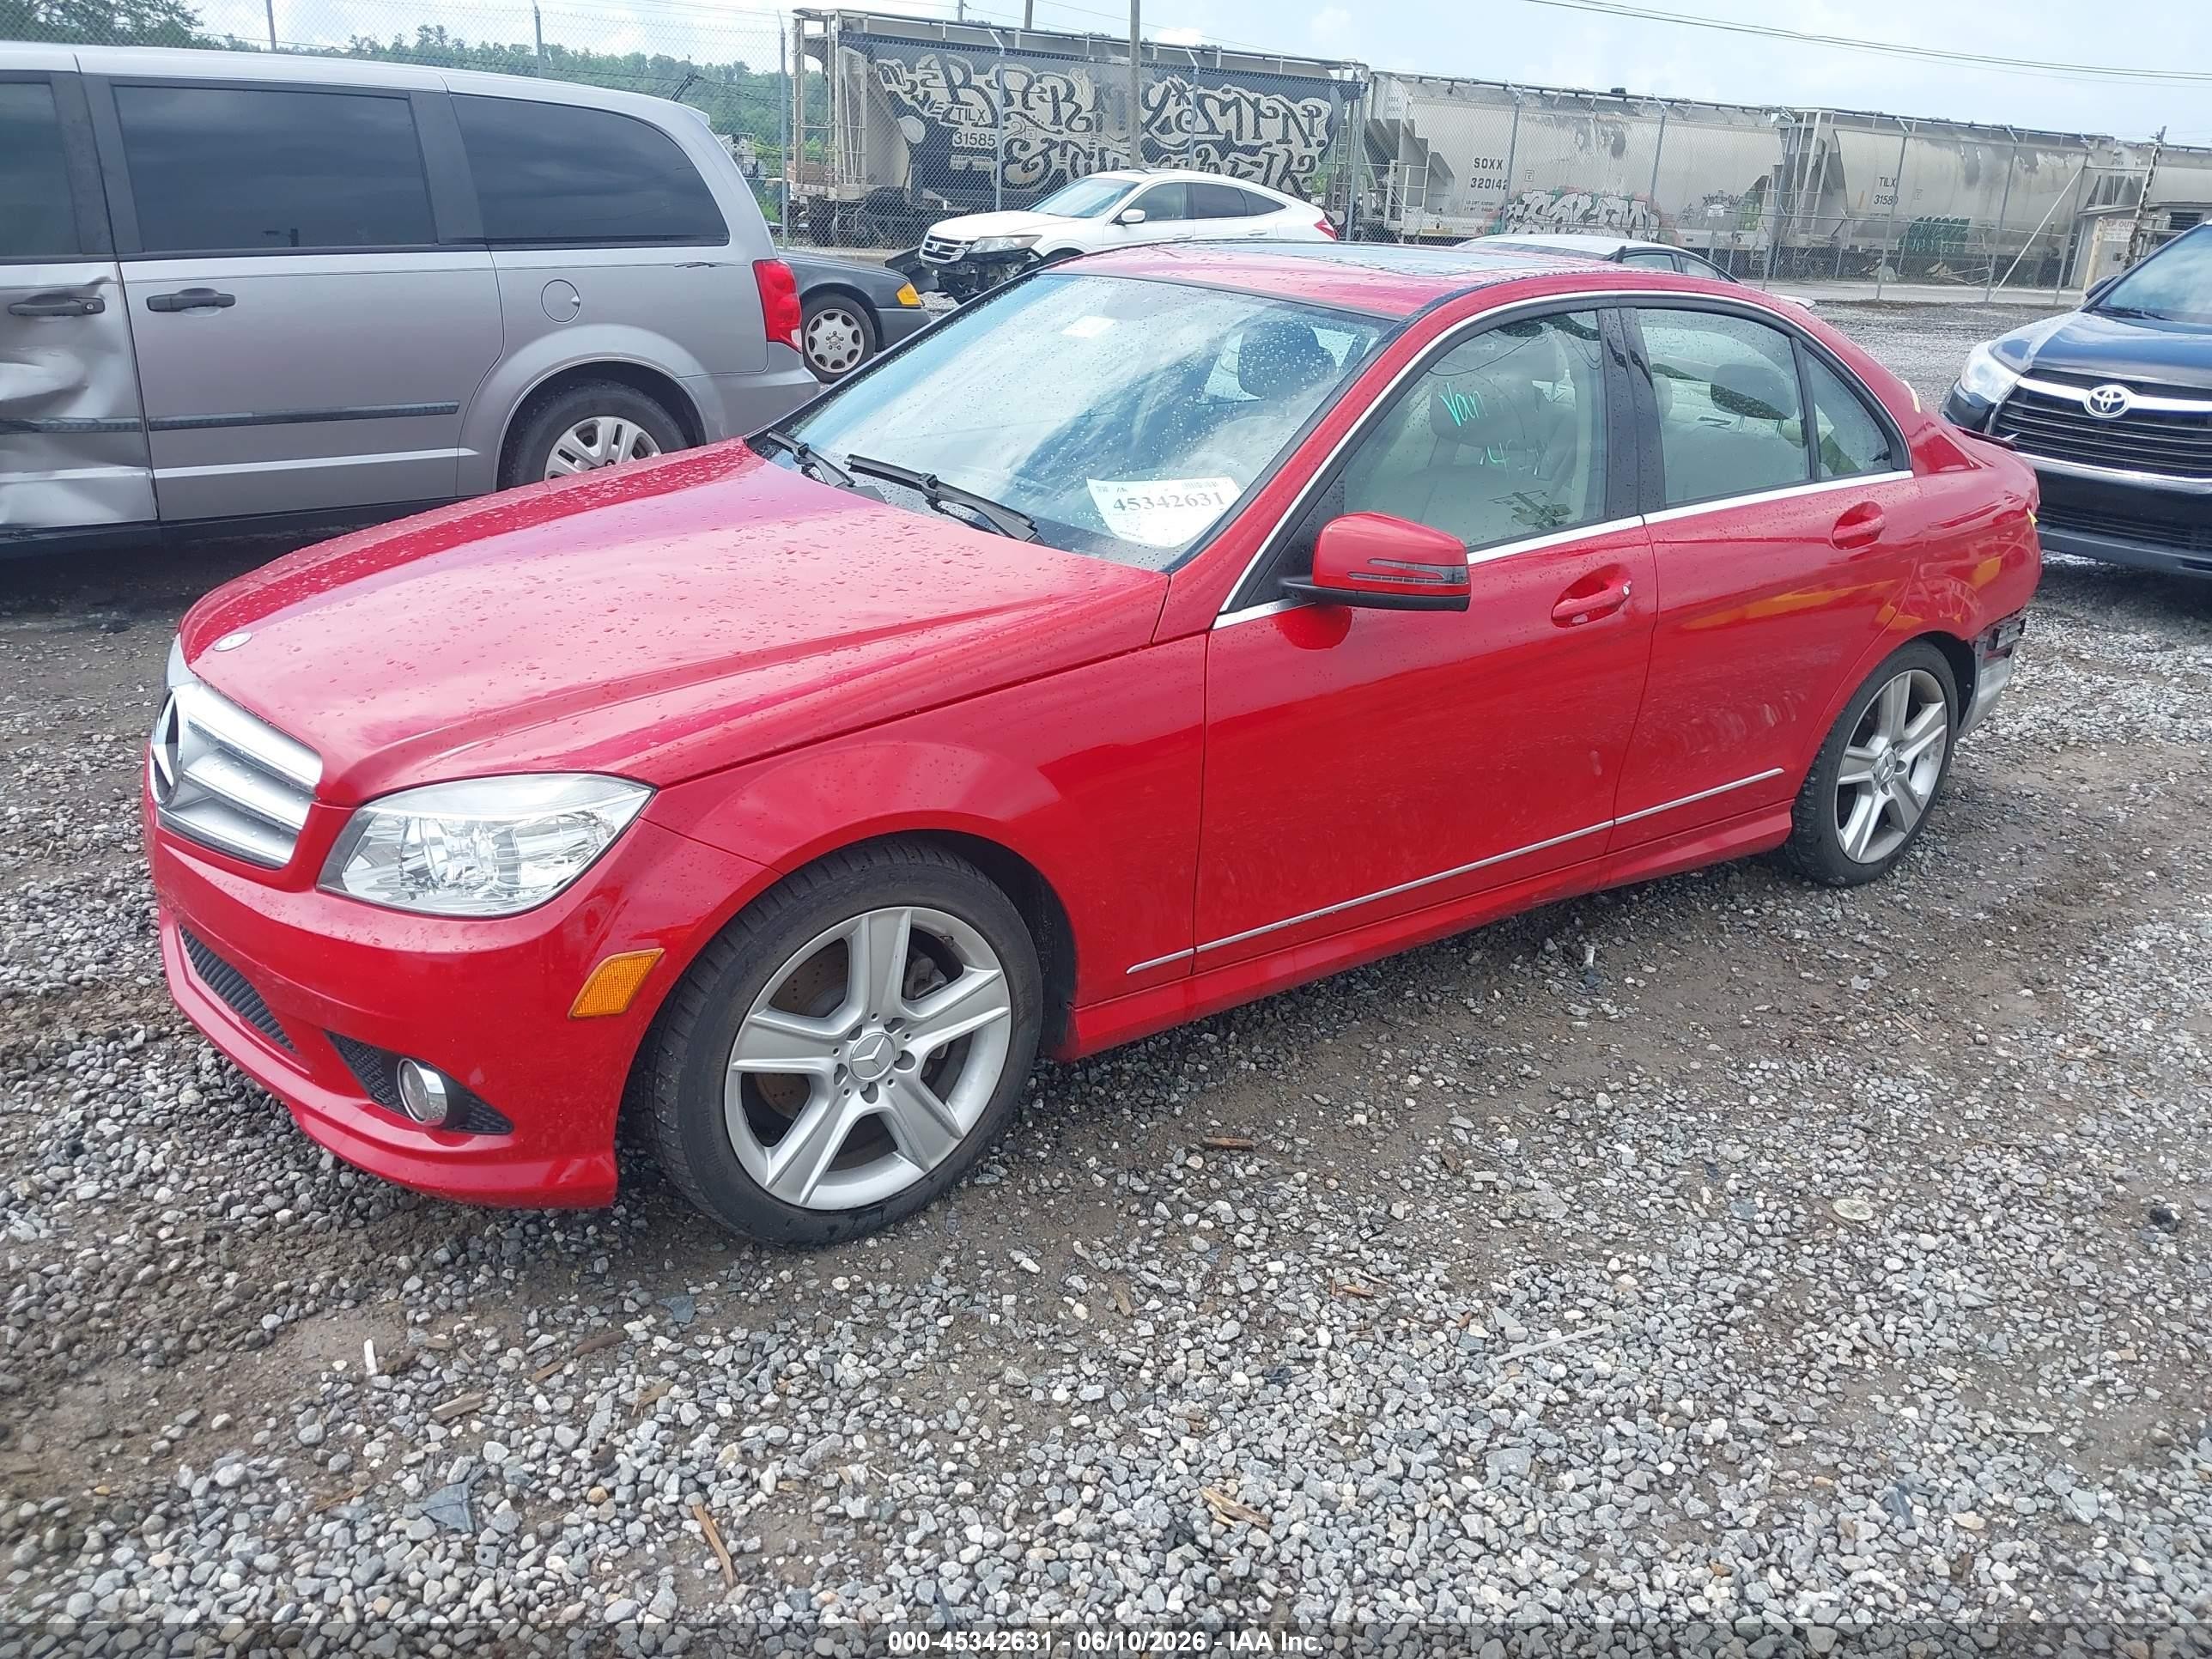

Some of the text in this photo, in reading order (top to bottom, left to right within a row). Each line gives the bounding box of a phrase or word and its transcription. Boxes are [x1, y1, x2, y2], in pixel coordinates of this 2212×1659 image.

[955, 107, 986, 122] TILX
[953, 131, 996, 146] 31585
[1474, 157, 1503, 170] SOXX
[1879, 177, 1896, 187] TILX
[1113, 491, 1225, 511] 45342631
